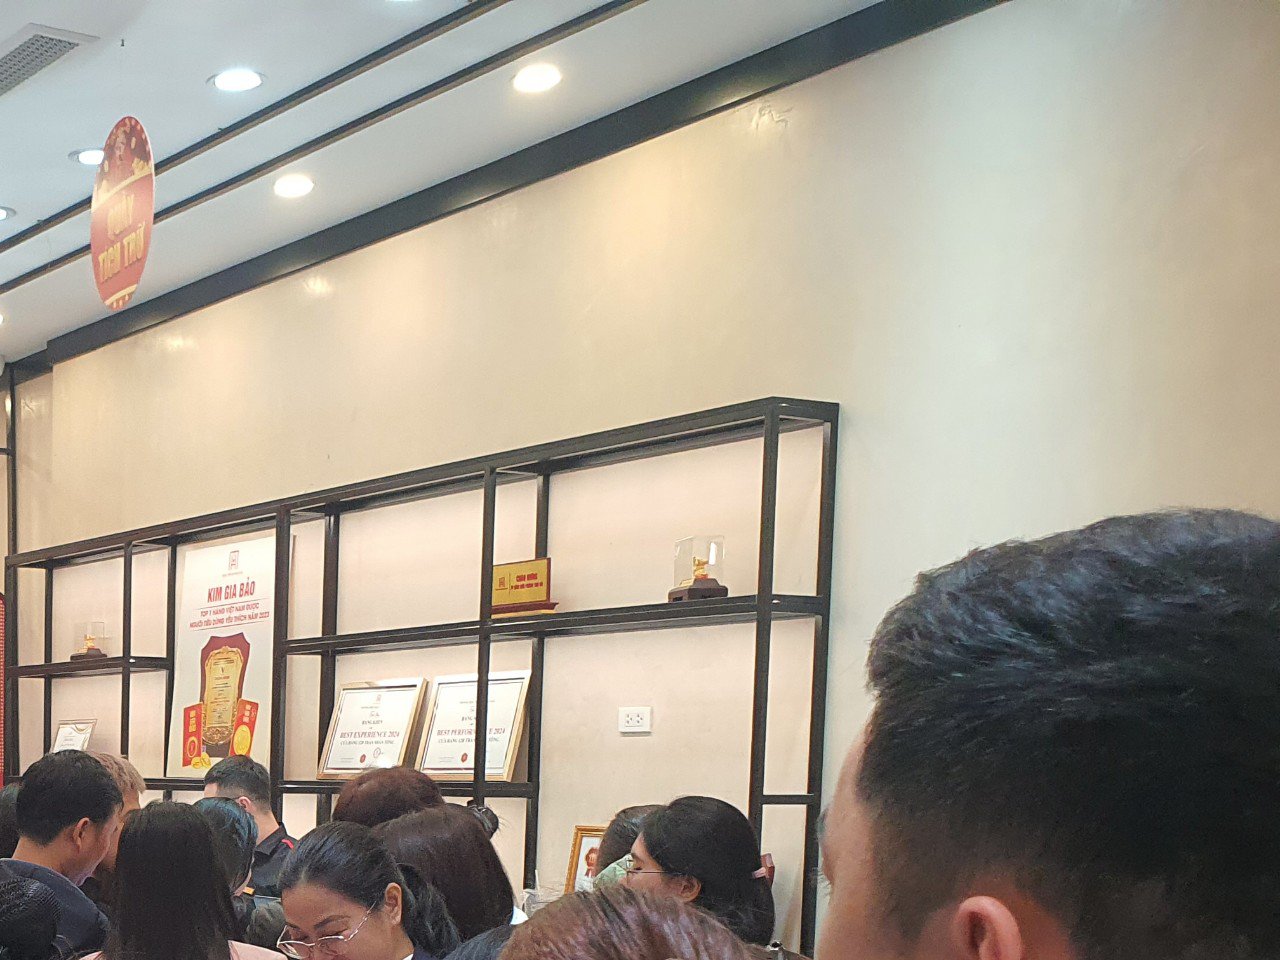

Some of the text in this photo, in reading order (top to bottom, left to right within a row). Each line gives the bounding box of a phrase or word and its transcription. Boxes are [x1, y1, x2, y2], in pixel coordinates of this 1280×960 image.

[207, 577, 256, 603] KIM GIA BẢO
